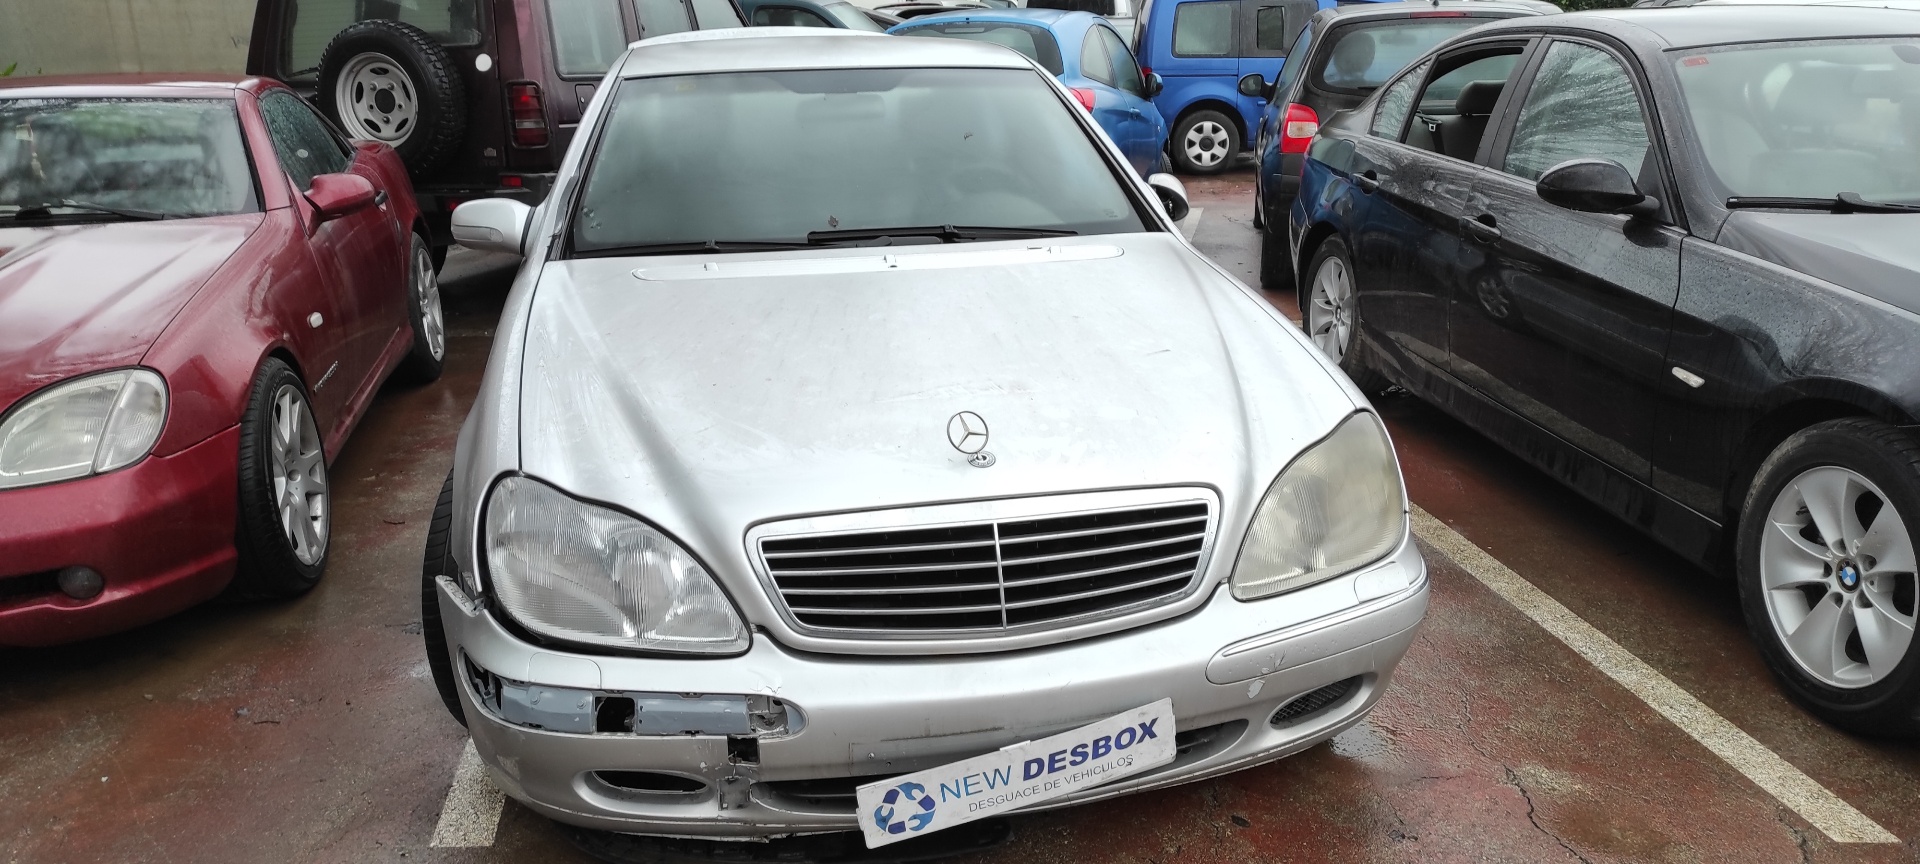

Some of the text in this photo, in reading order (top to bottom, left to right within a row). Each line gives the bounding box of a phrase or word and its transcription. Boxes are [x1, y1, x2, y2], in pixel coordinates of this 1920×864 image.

[940, 717, 1160, 803] NEW DESBOX
[969, 754, 1134, 813] DESGUACE DE VEHICULOS
